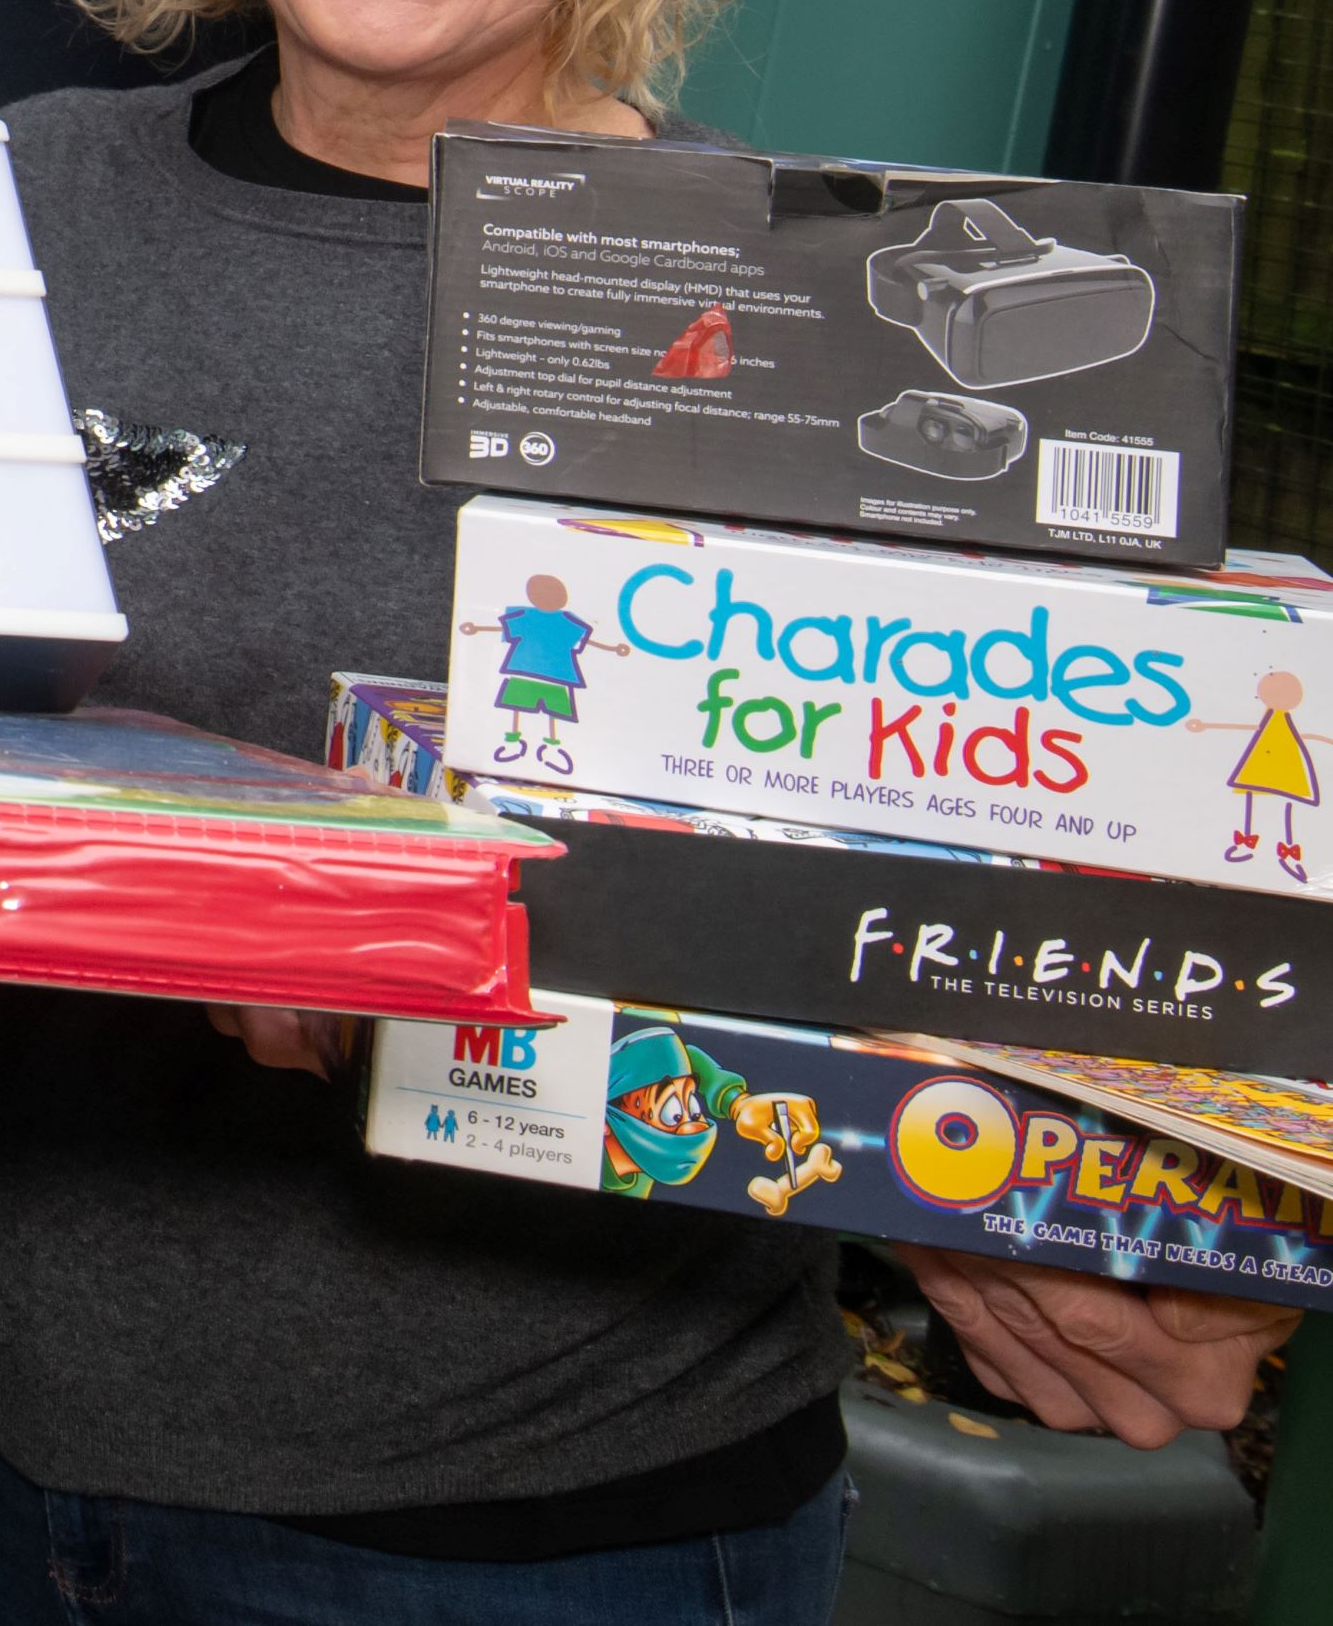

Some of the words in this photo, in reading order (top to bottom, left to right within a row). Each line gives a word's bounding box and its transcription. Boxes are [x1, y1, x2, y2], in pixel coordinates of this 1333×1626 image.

[485, 175, 530, 187] VIRTUAL
[531, 179, 575, 191] REALITY
[504, 186, 557, 198] SCOPE
[483, 223, 563, 242] Compatible
[567, 231, 597, 244] with
[601, 236, 638, 247] most
[482, 240, 539, 258] Android,
[543, 244, 568, 258] iOS
[571, 248, 597, 261] and
[600, 250, 651, 268] Google
[653, 254, 727, 272] Cardboard
[730, 263, 765, 277] apps
[480, 278, 550, 295] smartphone
[553, 284, 566, 295] to
[567, 287, 604, 299] create
[606, 288, 631, 305] fully
[633, 292, 695, 308] immersive
[698, 297, 735, 311] virtal
[738, 302, 825, 319] environments.
[481, 264, 548, 281] Lightweight
[551, 270, 638, 288] head-mounted
[640, 278, 682, 294] display
[684, 283, 723, 297] (HMD)
[725, 286, 750, 298] that
[753, 291, 781, 302] uses
[783, 294, 812, 304] your
[1065, 429, 1087, 439] Item
[1089, 431, 1120, 443] Code:
[1122, 436, 1154, 446] 41555
[1061, 509, 1099, 523] 1041
[1111, 513, 1153, 529] 5559
[1048, 528, 1070, 539] TJM
[1099, 534, 1116, 544] L11
[1145, 540, 1162, 549] UK
[616, 562, 1192, 730] Charades
[697, 667, 845, 760] for
[866, 695, 1090, 795] Kids
[661, 753, 715, 779] THREE
[726, 764, 752, 784] OR
[763, 769, 819, 795] MORE
[831, 779, 914, 809] PLAYERS
[926, 793, 977, 818] AGES
[989, 803, 1043, 829] FOUR
[1055, 813, 1094, 837] AND
[1107, 820, 1138, 844] UP
[931, 975, 973, 994] THE
[984, 980, 1122, 1010] TELEVISION
[1132, 998, 1214, 1021] SERIES
[453, 1026, 537, 1070] MB
[449, 1067, 537, 1098] GAMES
[468, 1110, 478, 1124] 6
[495, 1115, 515, 1130] 12
[519, 1121, 565, 1139] years
[466, 1134, 476, 1148] 2
[493, 1139, 504, 1152] 4
[509, 1143, 573, 1164] players
[984, 1213, 1026, 1235] THE
[1032, 1221, 1096, 1248] GAME
[1101, 1233, 1160, 1258] THAT
[1165, 1242, 1235, 1271] NEEDS
[1240, 1255, 1256, 1274] A
[1262, 1260, 1333, 1288] STEAD
